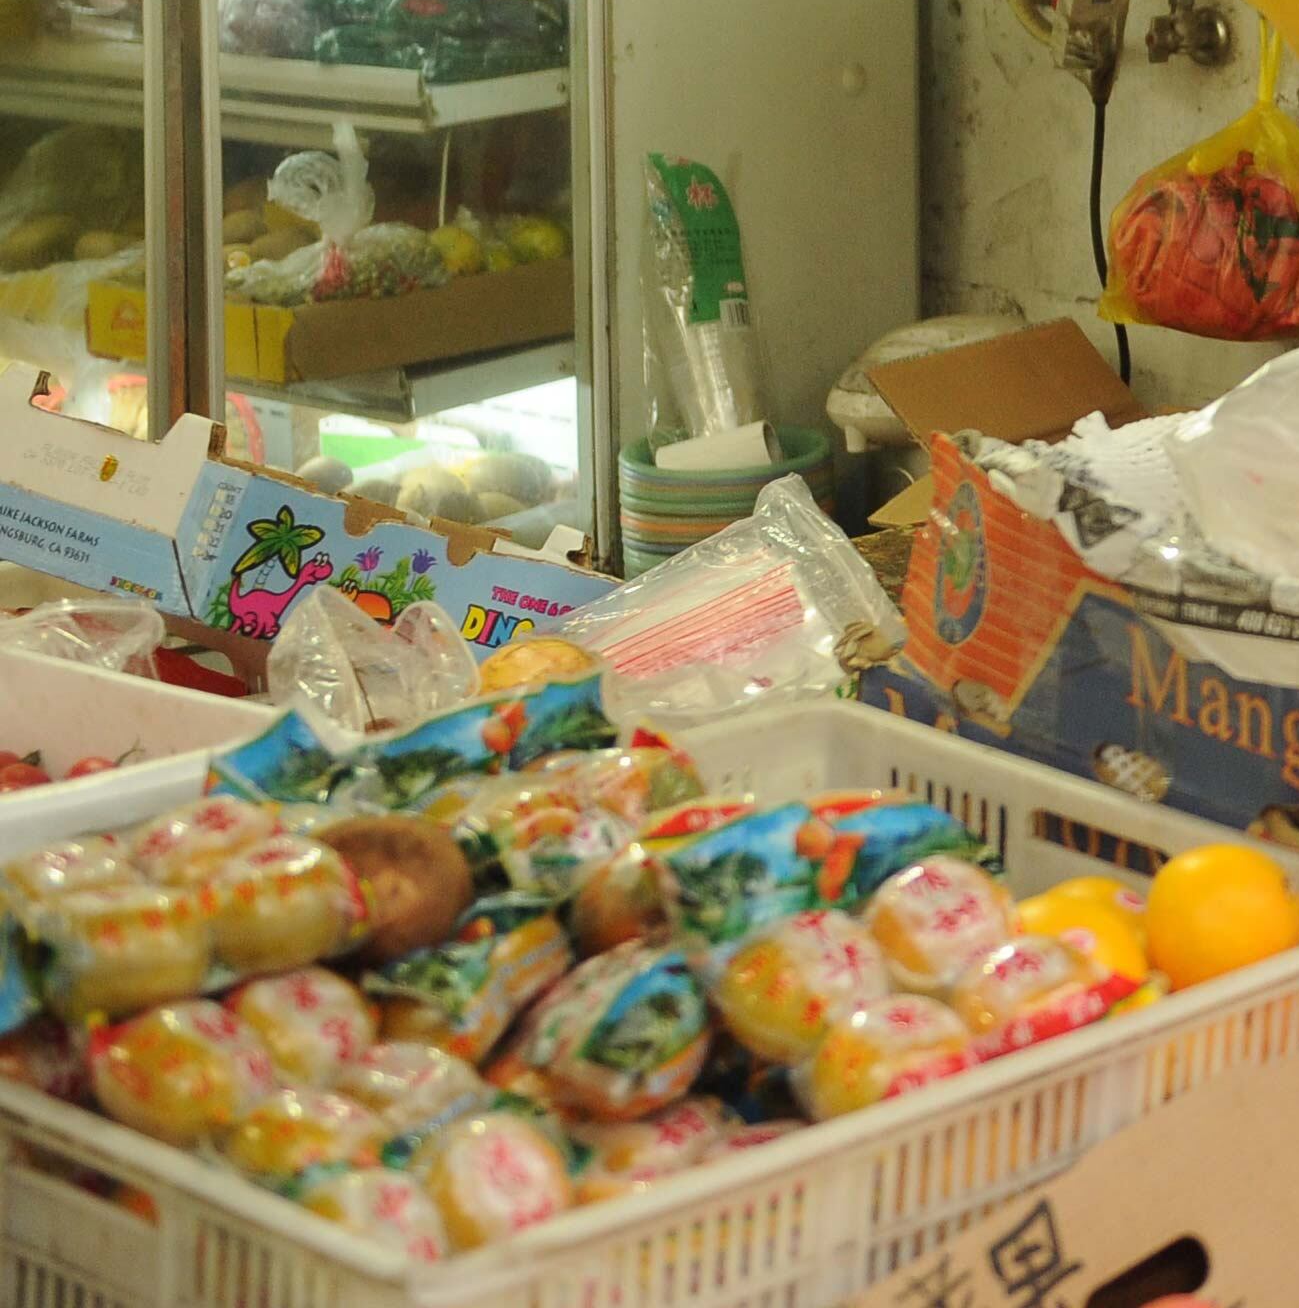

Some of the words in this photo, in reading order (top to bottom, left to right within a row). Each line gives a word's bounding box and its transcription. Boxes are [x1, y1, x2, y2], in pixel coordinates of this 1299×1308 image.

[19, 511, 64, 536] JACKSON
[65, 524, 100, 547] FARMS
[48, 542, 62, 556] CA
[491, 585, 519, 606] THE
[519, 594, 549, 614] ONE
